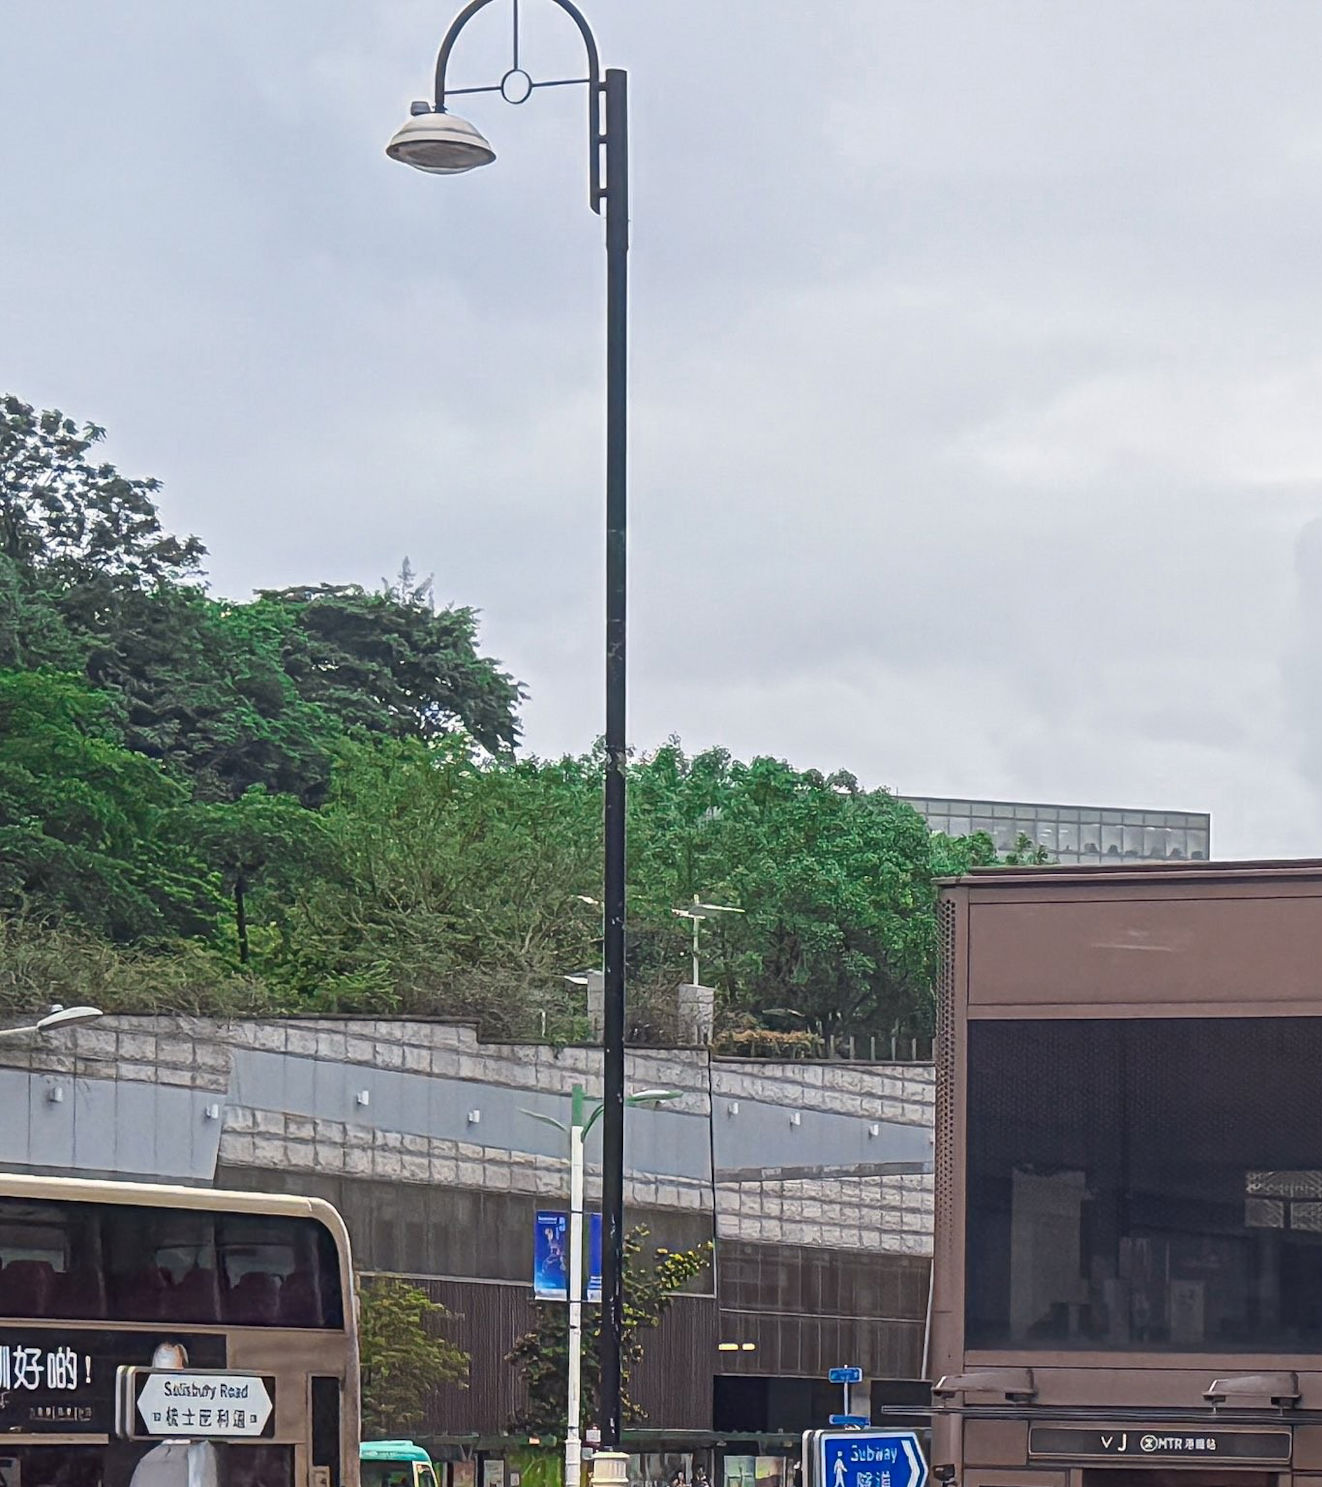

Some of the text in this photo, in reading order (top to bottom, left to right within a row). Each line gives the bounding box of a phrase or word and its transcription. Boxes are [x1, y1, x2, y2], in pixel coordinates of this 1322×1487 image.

[164, 1381, 249, 1400] Salisbury Road
[1158, 1437, 1182, 1450] MTR
[850, 1444, 898, 1464] Subway
